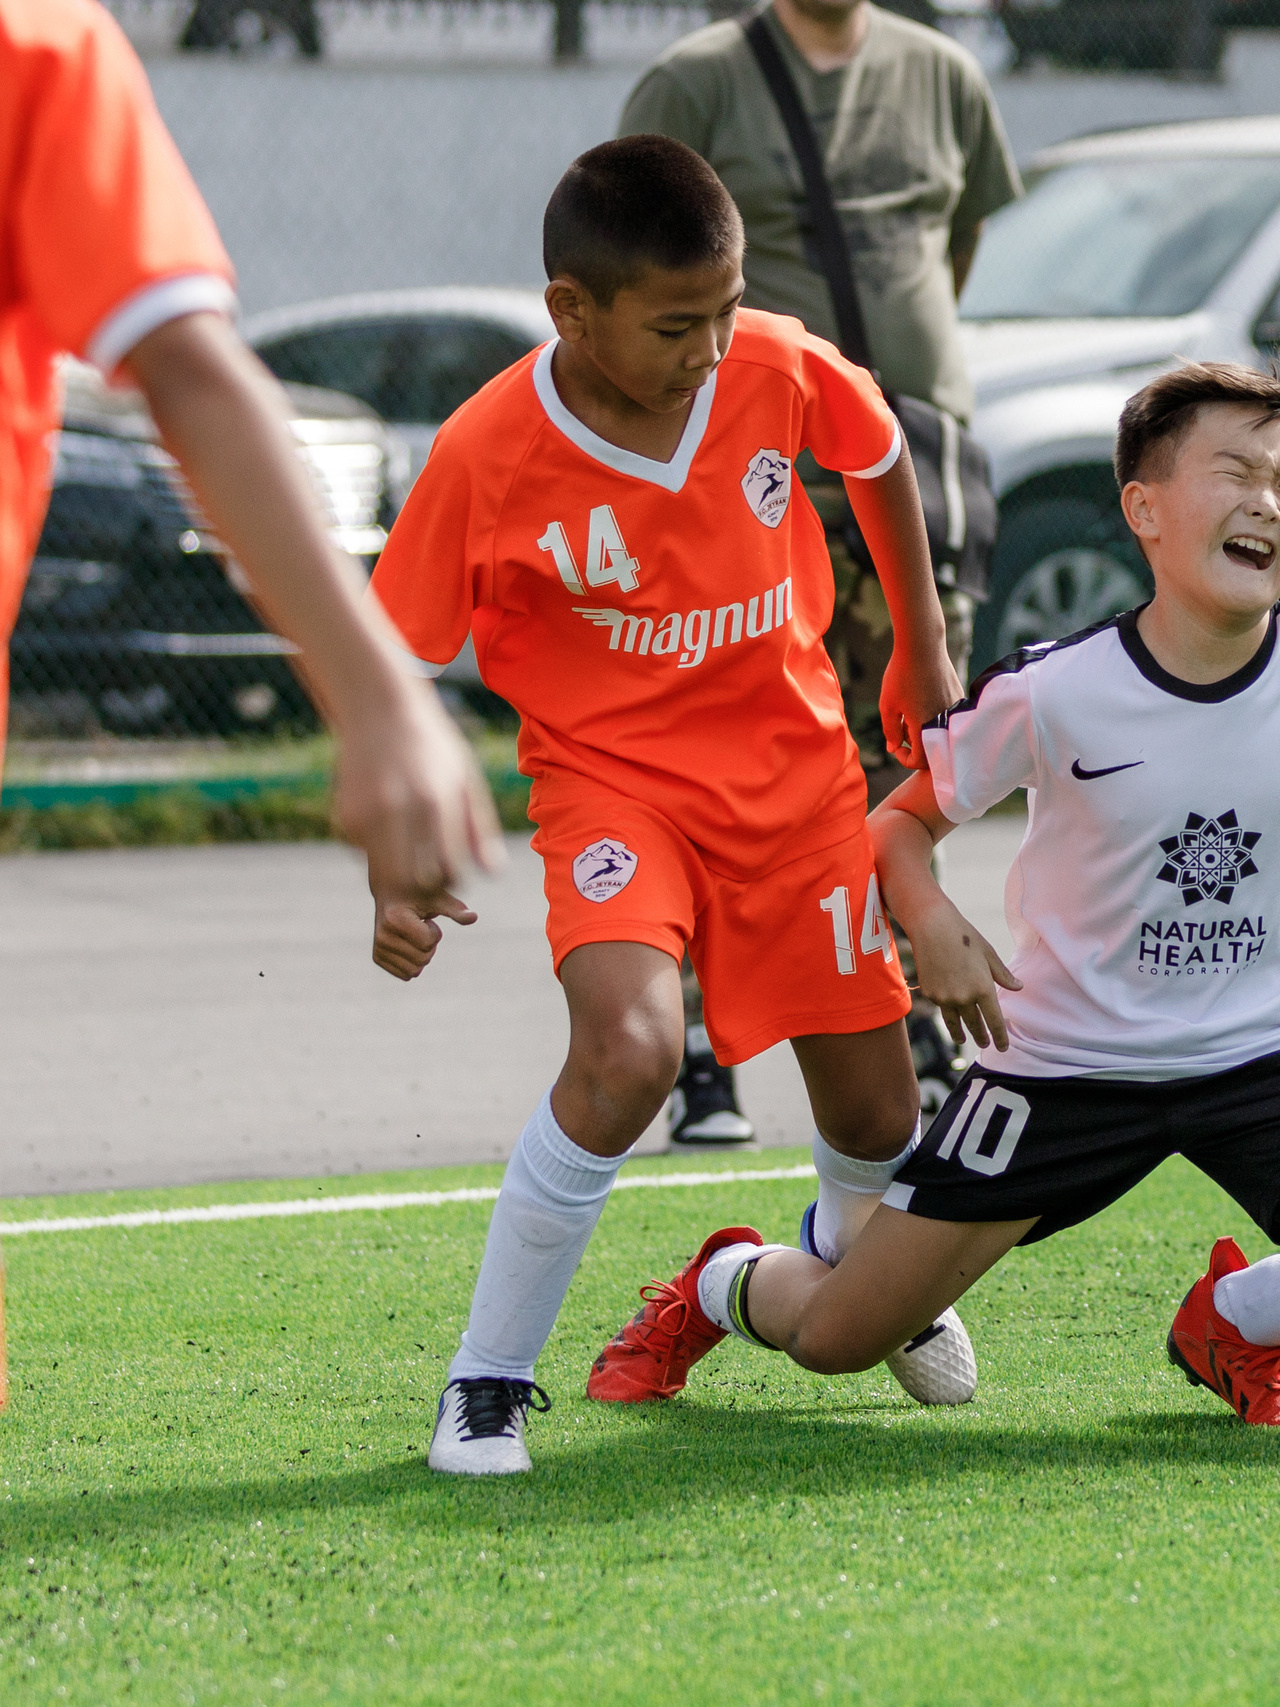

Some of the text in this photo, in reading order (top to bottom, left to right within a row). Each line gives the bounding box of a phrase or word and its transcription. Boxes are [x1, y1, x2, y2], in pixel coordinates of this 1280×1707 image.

[536, 504, 640, 596] 14
[819, 872, 893, 975] 14
[1139, 938, 1265, 967] HEALTH
[1140, 915, 1267, 943] NATURAL
[1137, 959, 1257, 977] CORPORATI
[936, 1078, 1031, 1177] 10
